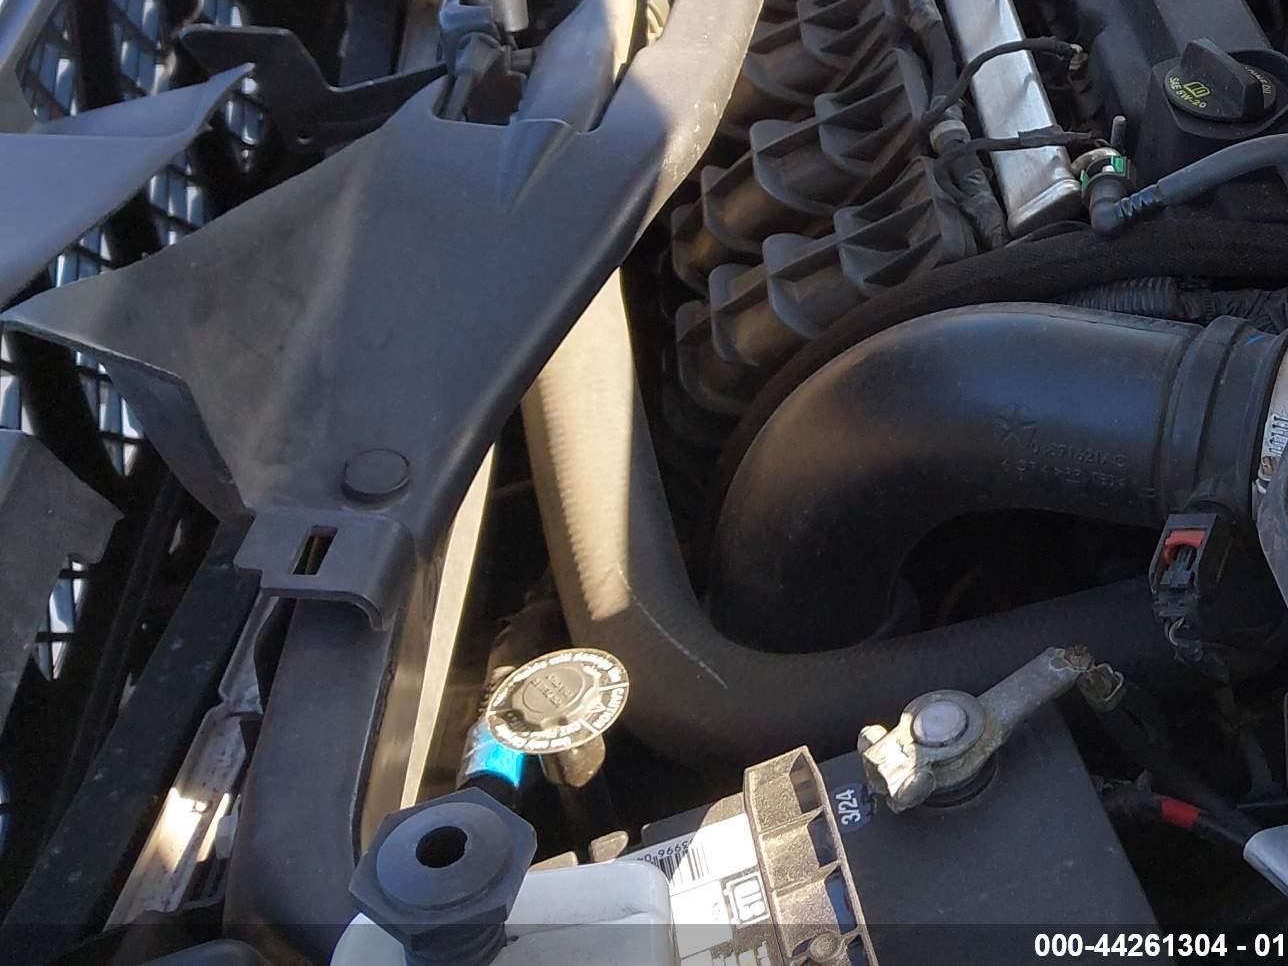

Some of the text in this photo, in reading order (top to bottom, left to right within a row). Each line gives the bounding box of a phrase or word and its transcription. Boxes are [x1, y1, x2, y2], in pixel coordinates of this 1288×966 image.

[1176, 89, 1207, 109] 5W-20
[592, 688, 625, 730] CAUTION
[836, 788, 861, 825] 3/24
